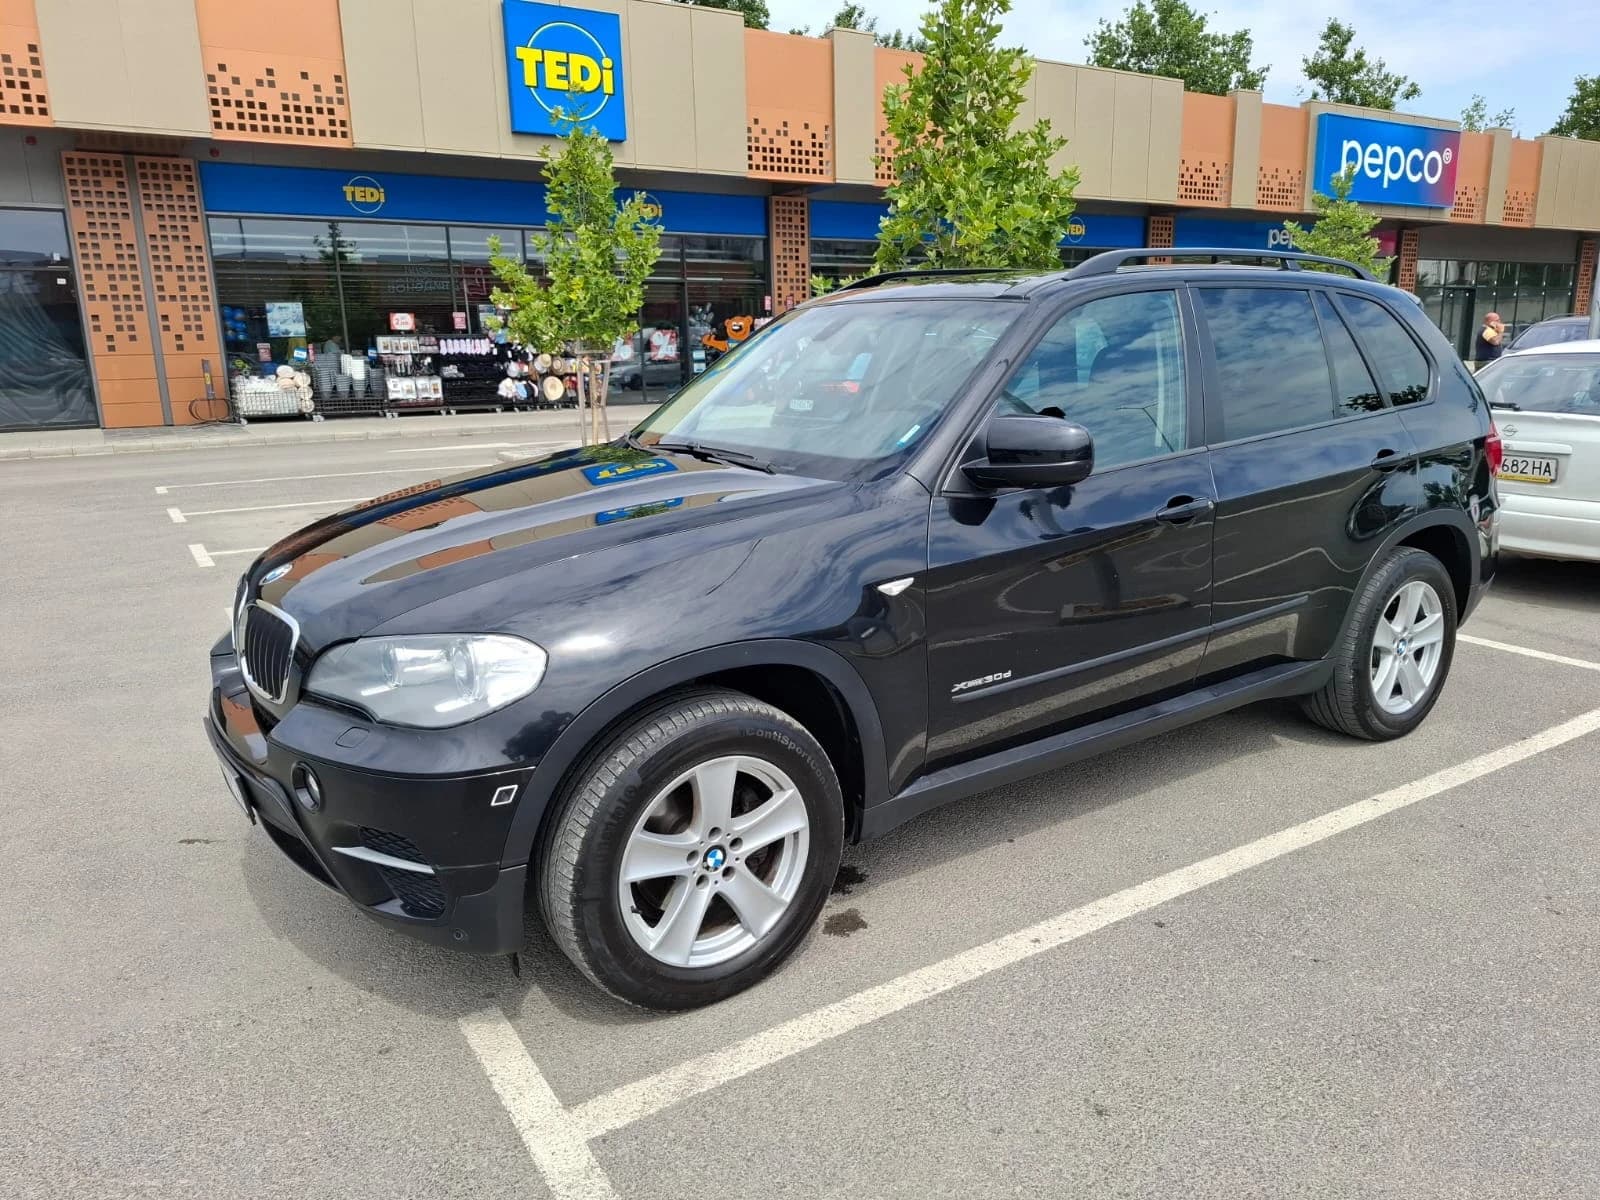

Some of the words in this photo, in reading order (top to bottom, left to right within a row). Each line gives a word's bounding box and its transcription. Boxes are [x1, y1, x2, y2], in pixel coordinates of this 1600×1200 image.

[515, 46, 614, 95] TEDi
[1340, 139, 1443, 188] pepco
[342, 186, 385, 203] TEDi
[1501, 459, 1529, 474] 682
[1531, 460, 1552, 477] HA
